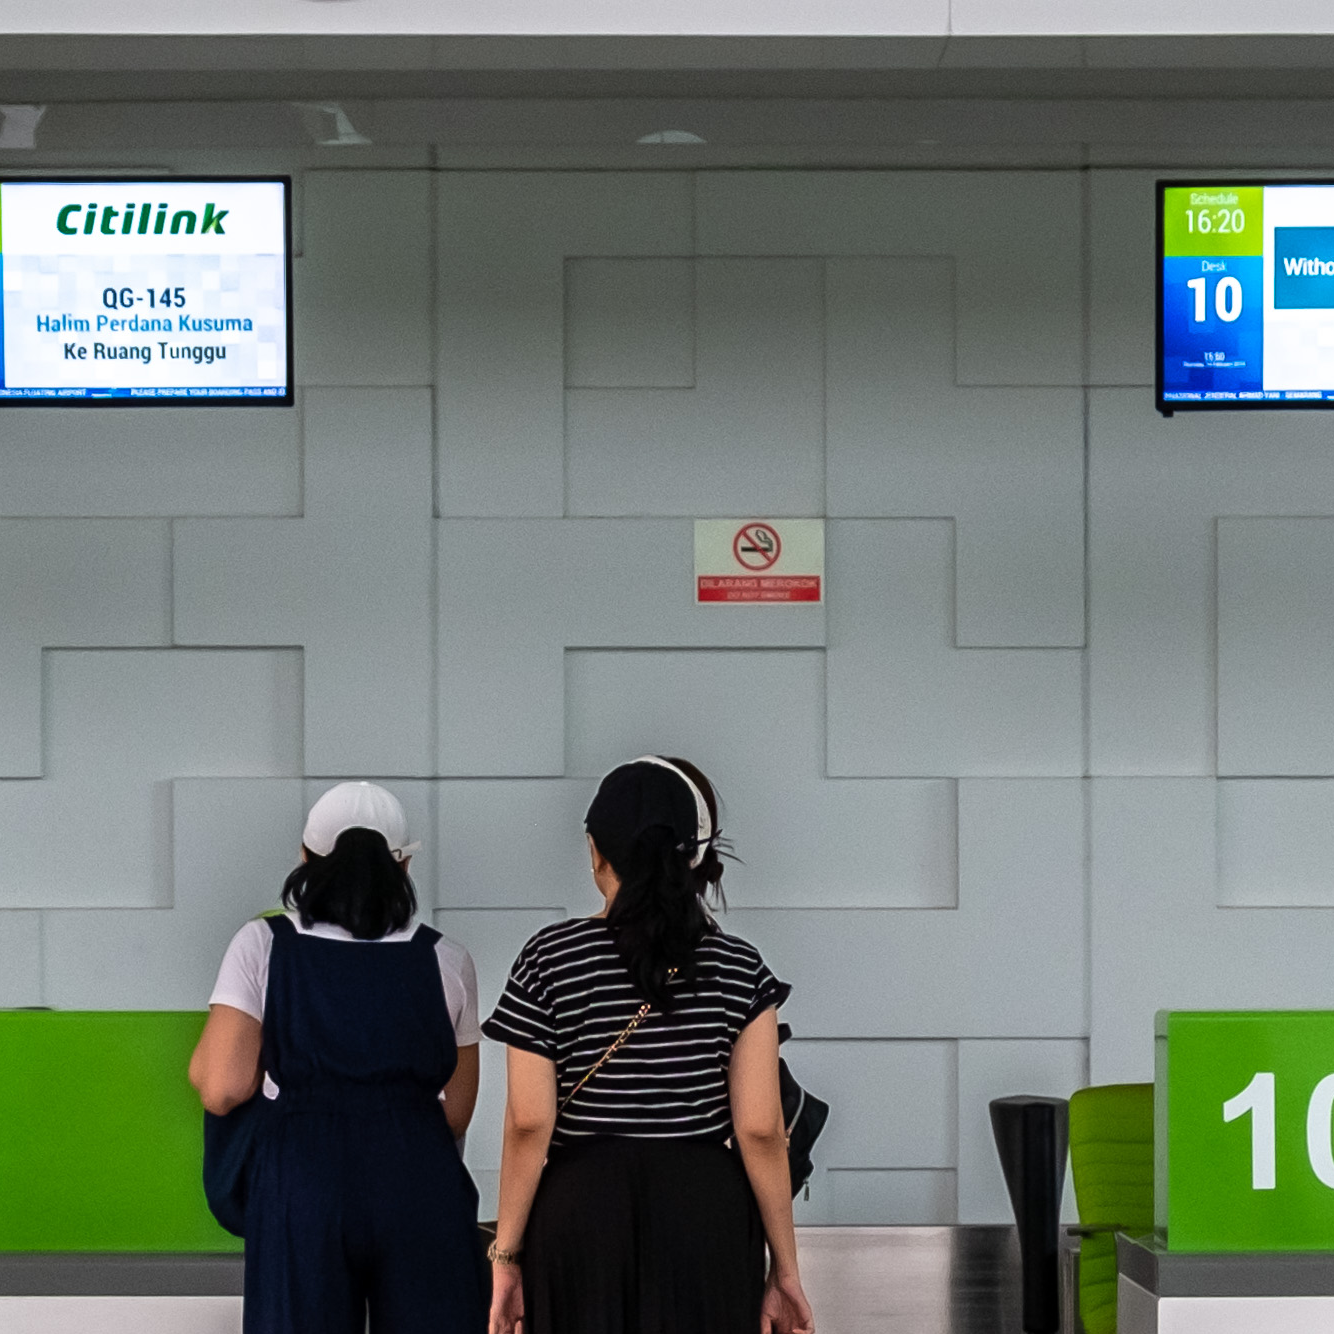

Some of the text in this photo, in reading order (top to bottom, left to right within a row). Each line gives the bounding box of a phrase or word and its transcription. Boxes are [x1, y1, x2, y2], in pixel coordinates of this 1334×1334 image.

[1190, 193, 1239, 205] Schedule
[56, 203, 229, 235] Citilink
[1186, 209, 1245, 233] 16:20
[1202, 260, 1227, 272] Desk
[102, 287, 186, 308] QG-145
[1187, 276, 1243, 322] 10
[37, 314, 253, 332] Halim Perdana Kusuma
[64, 343, 227, 364] Ke Ruang Tunggu
